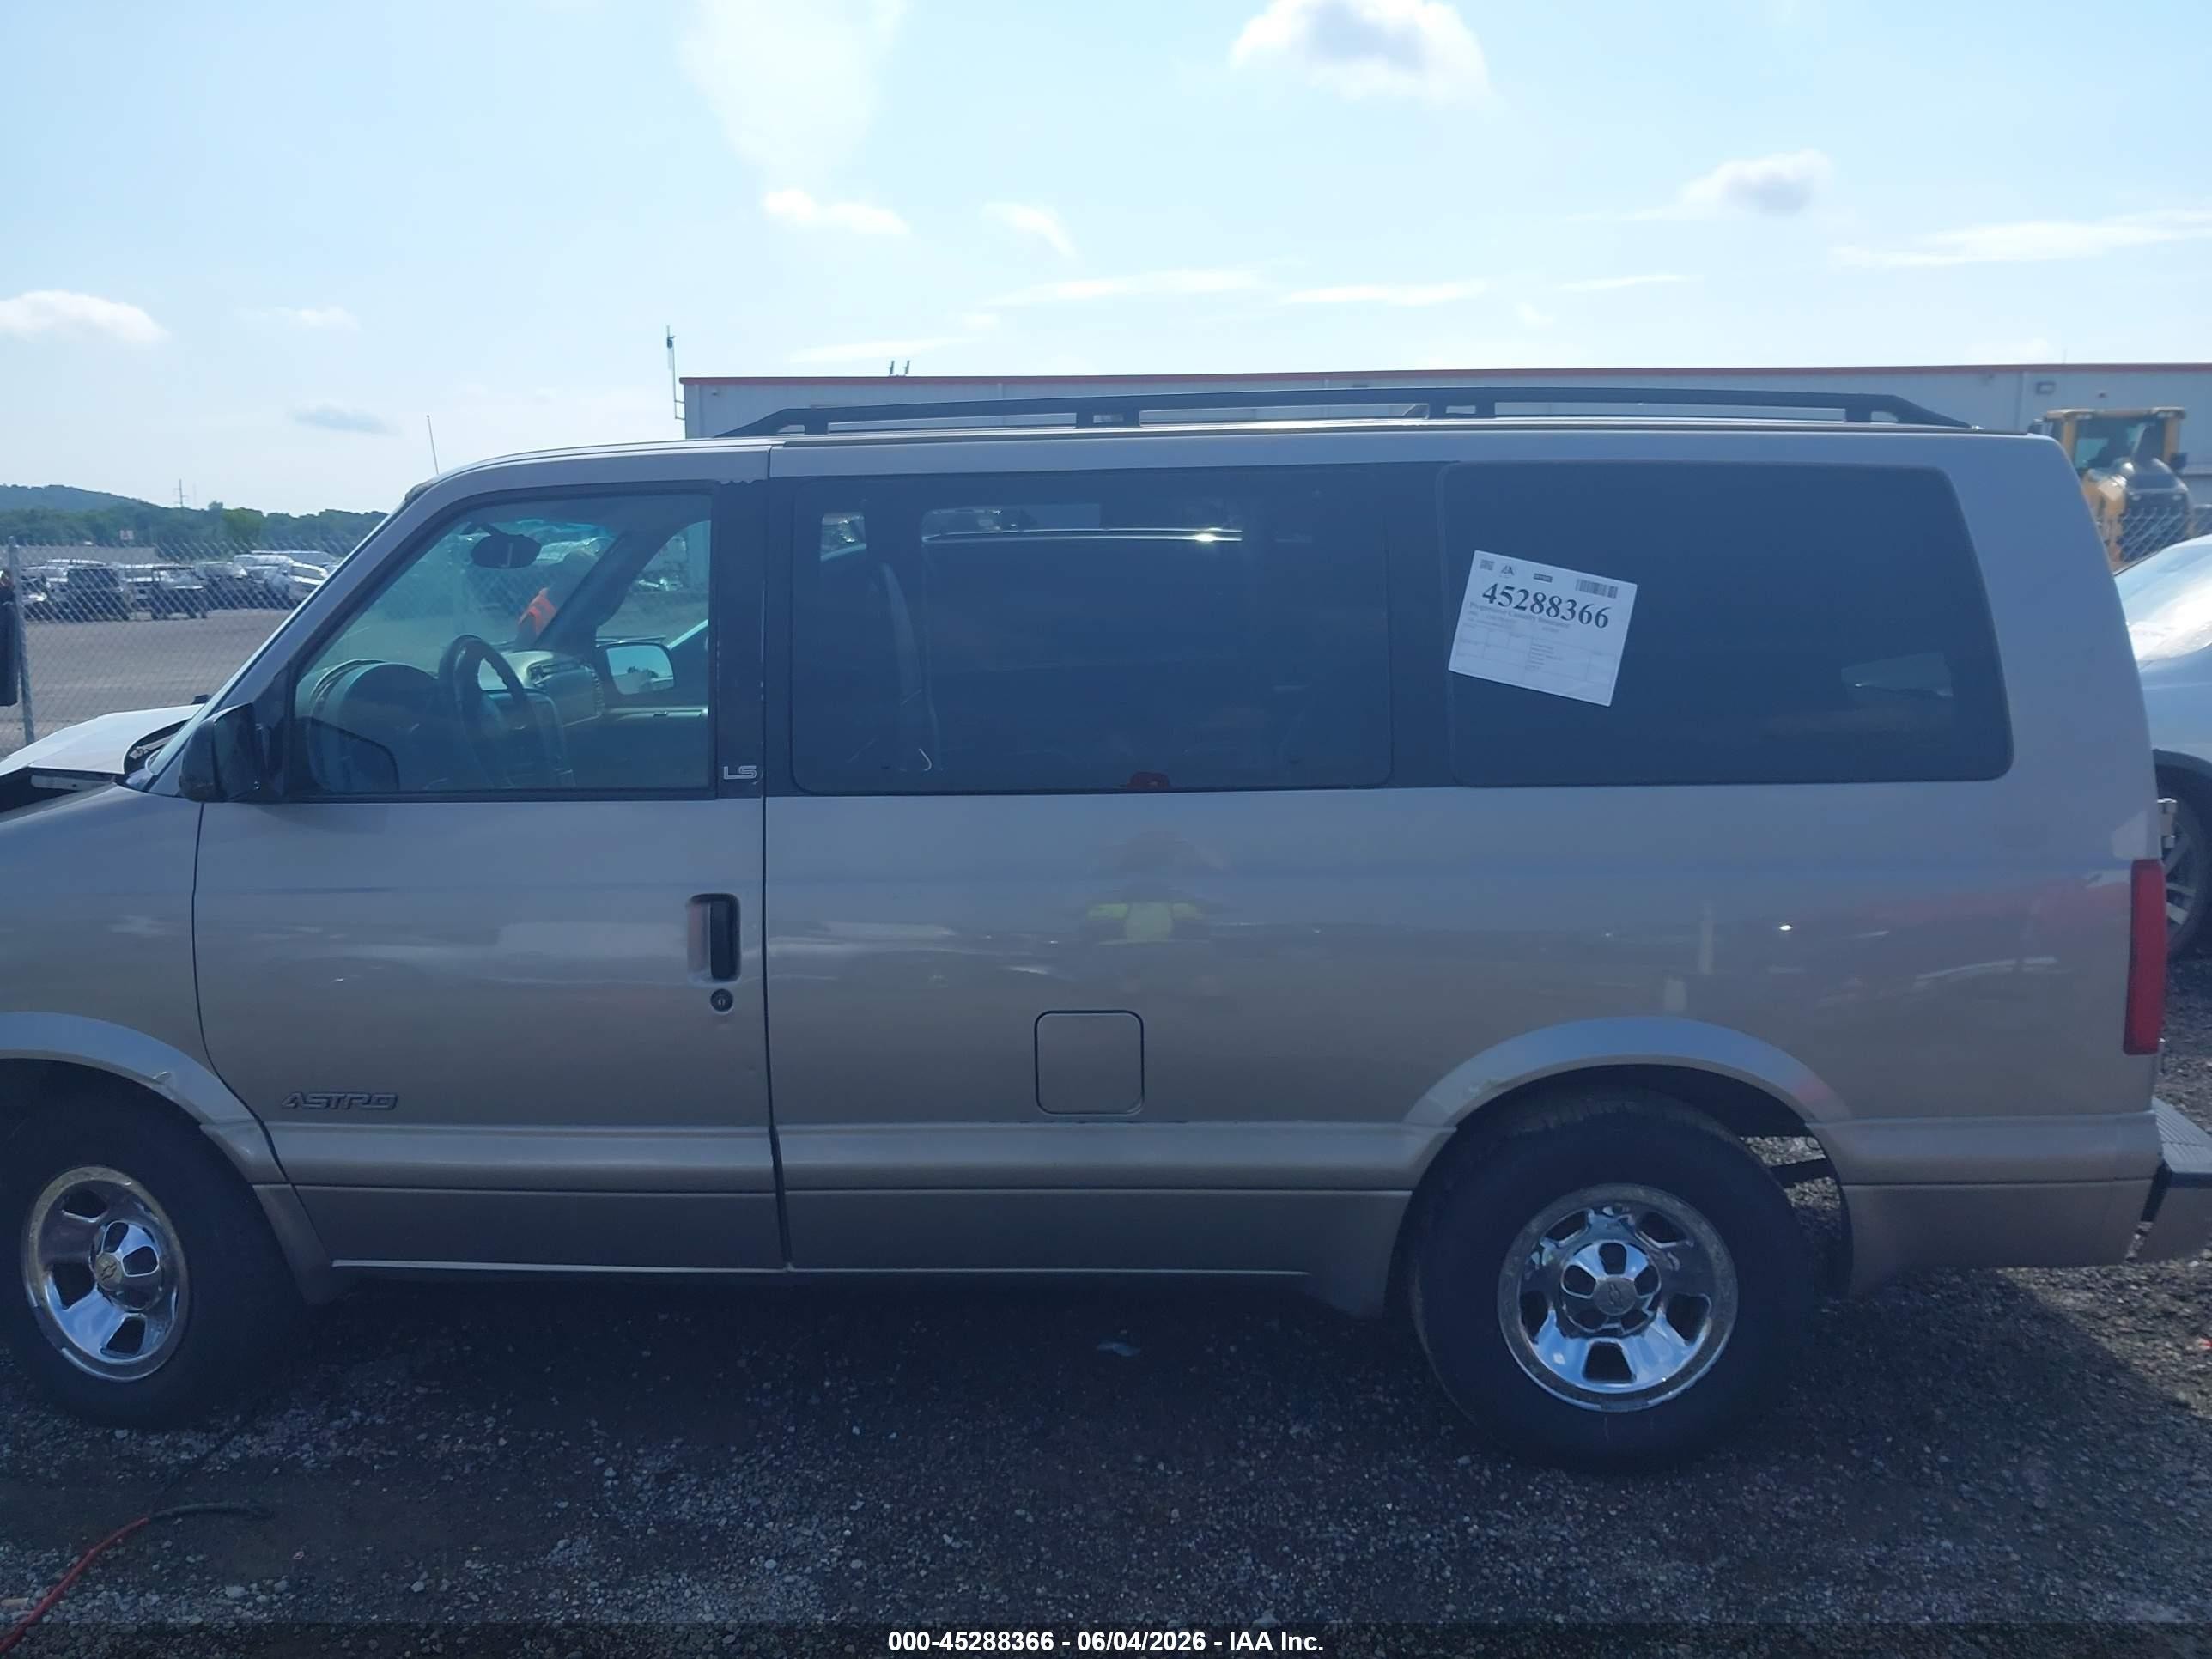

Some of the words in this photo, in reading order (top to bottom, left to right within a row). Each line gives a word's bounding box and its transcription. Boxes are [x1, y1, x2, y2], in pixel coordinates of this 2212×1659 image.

[1482, 583, 1612, 629] 45288366
[723, 765, 757, 780] LS
[281, 1091, 399, 1111] ASTRO
